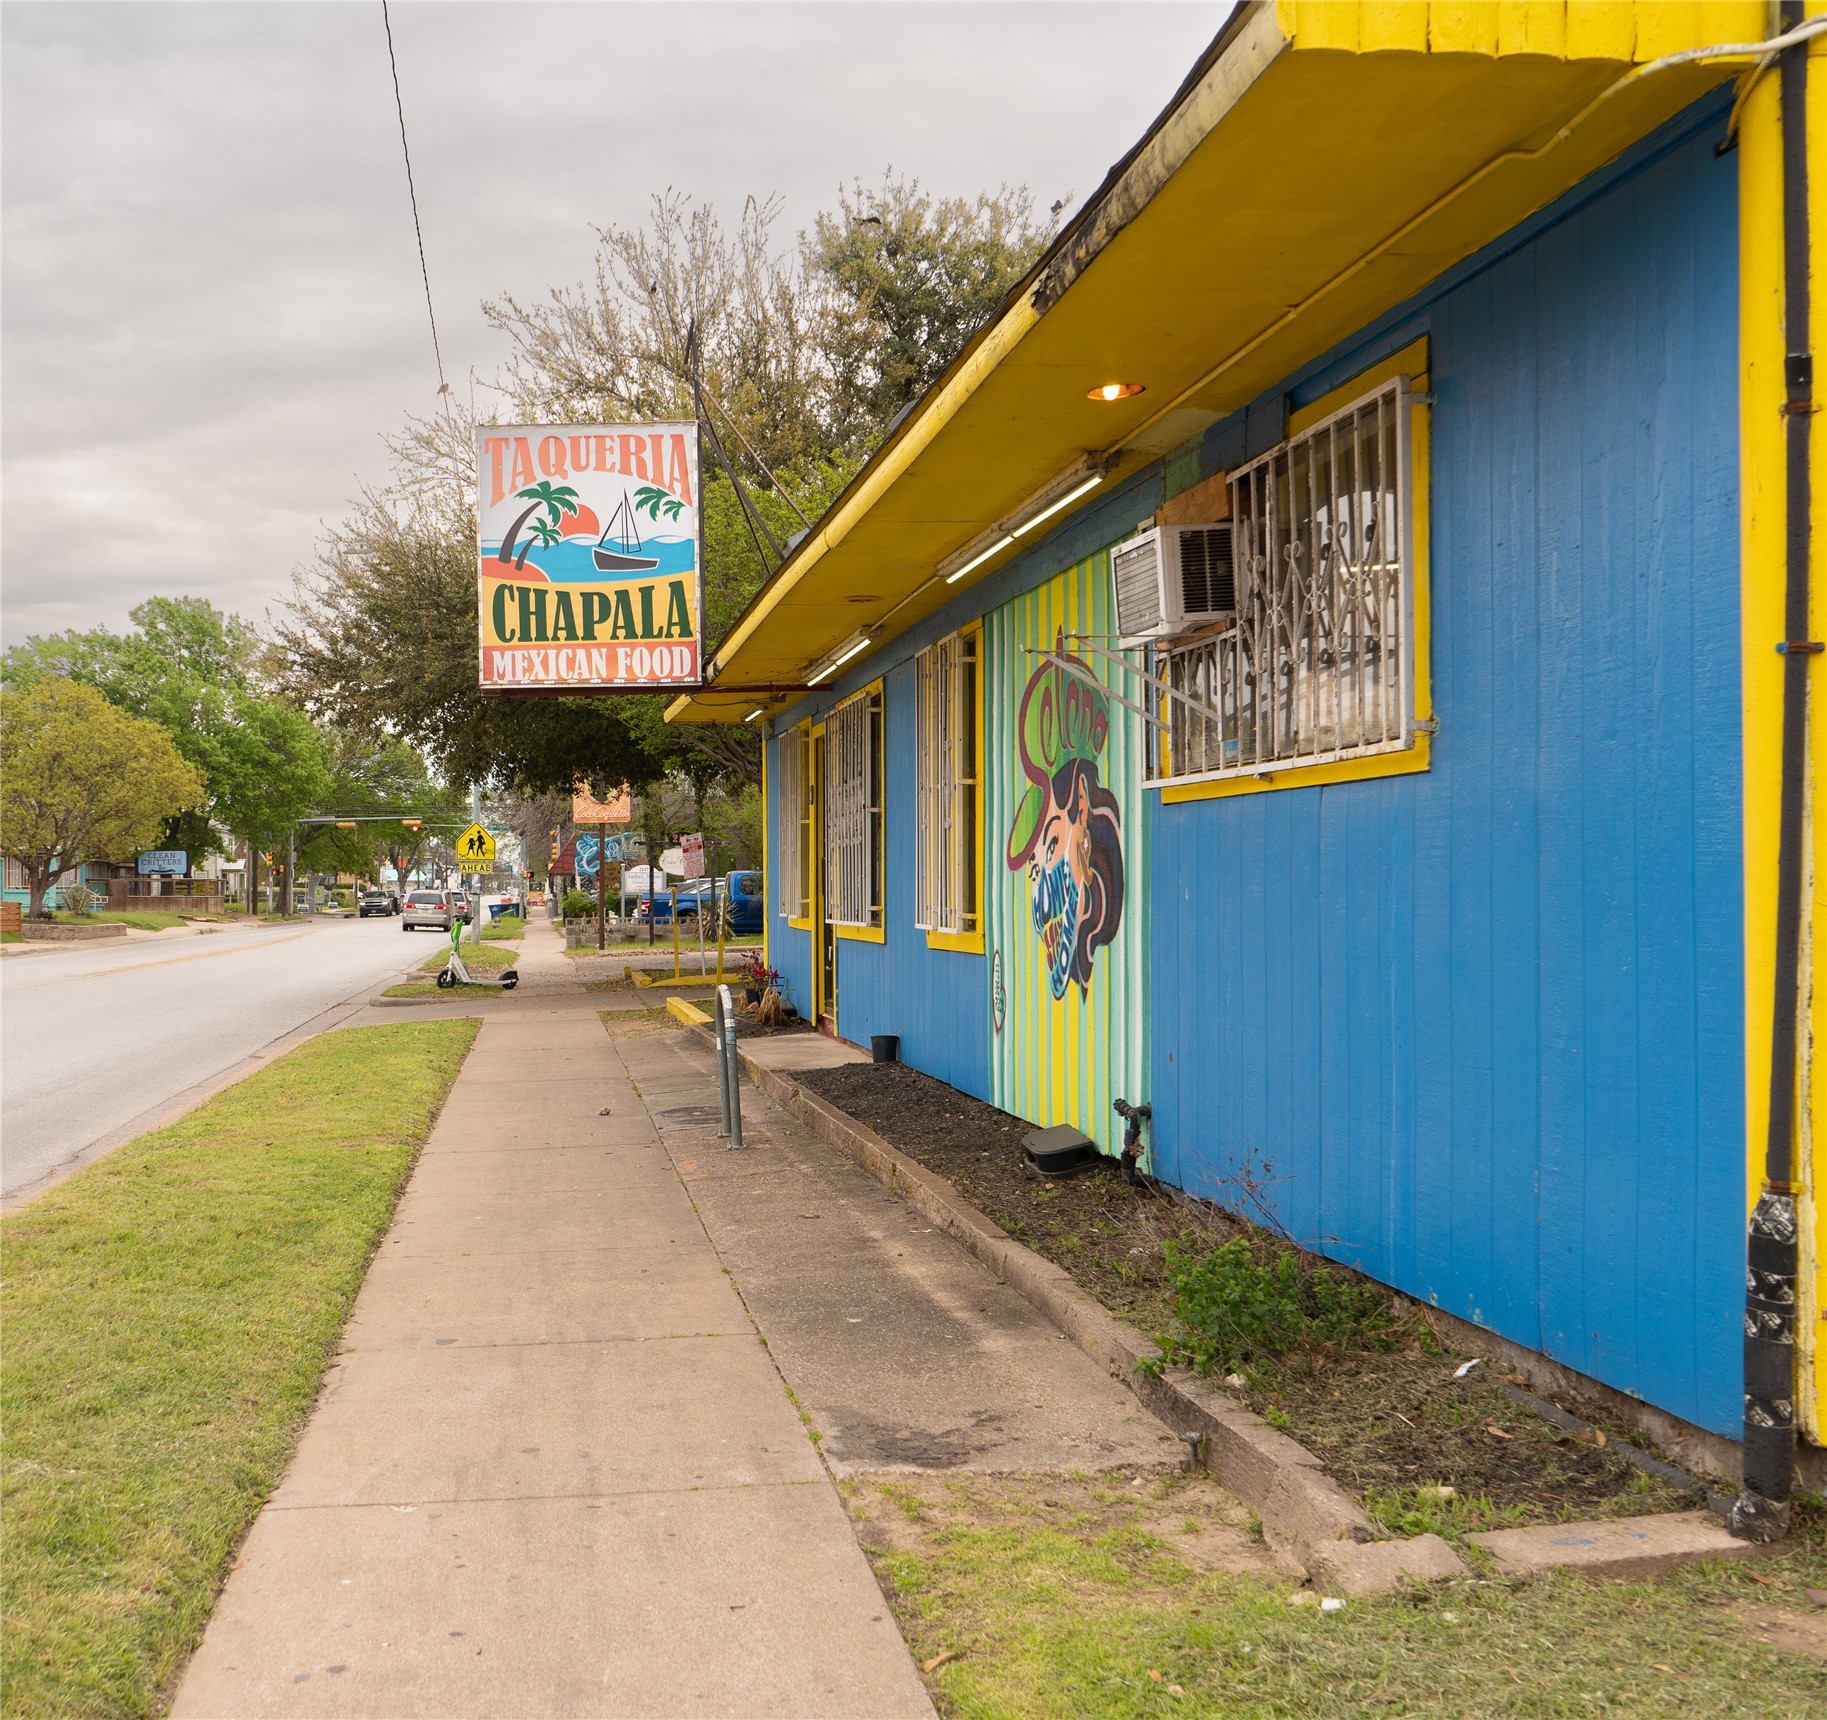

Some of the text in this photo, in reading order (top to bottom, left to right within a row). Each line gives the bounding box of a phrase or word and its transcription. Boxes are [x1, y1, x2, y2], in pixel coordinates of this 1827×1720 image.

[485, 433, 693, 508] TAQUERIA
[492, 580, 693, 643] CHAPALA
[492, 646, 692, 682] MEXICAN FOOD
